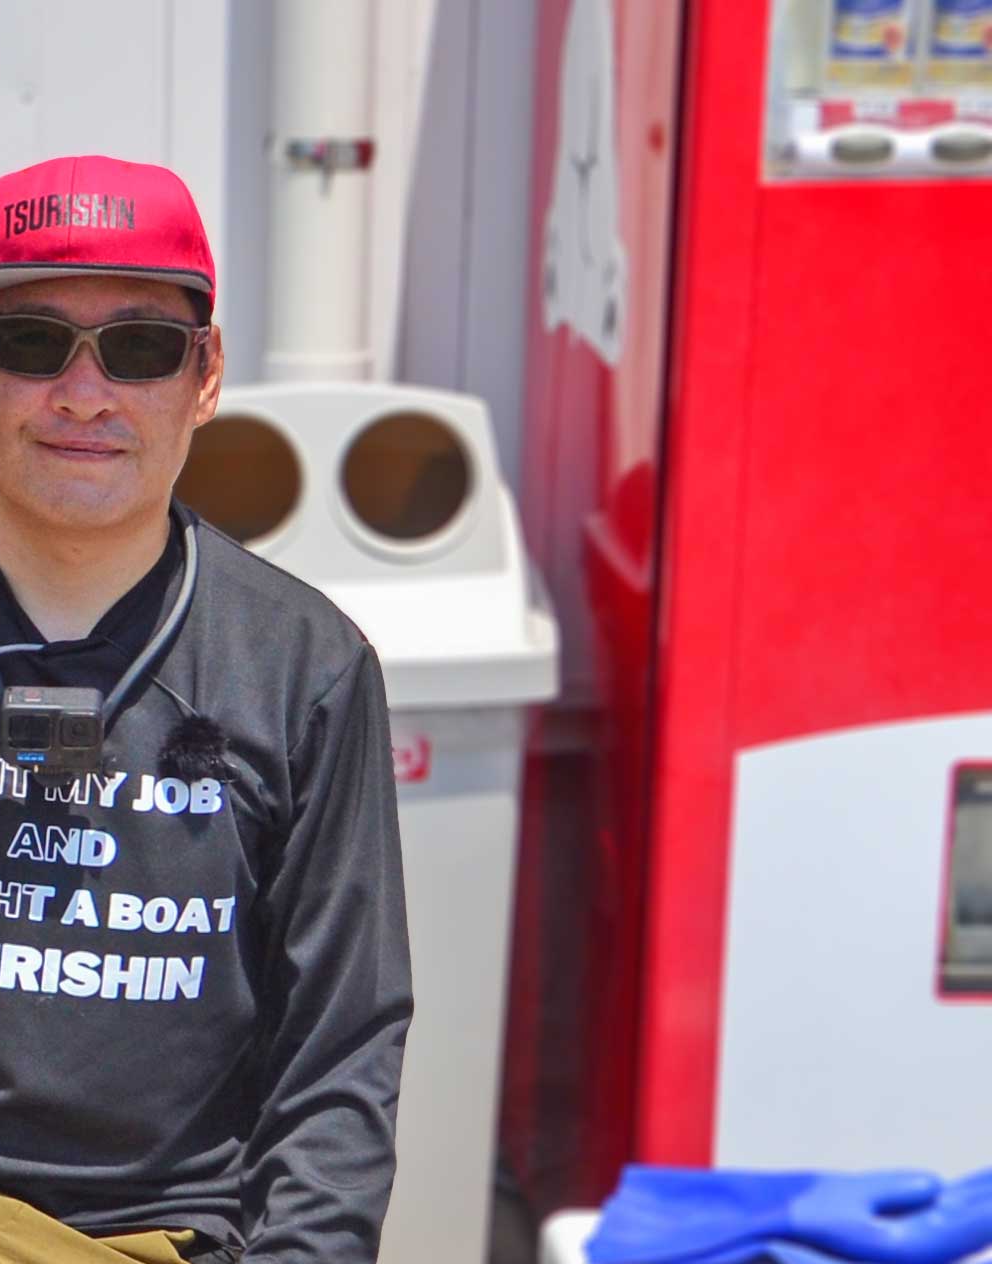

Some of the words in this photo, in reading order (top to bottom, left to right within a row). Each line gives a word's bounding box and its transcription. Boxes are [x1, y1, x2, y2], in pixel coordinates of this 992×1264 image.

[4, 192, 135, 239] TSURISHIN
[44, 770, 128, 808] MY
[132, 775, 223, 815] JOB
[7, 823, 117, 867] AND
[61, 889, 99, 928] A
[107, 892, 236, 934] BOAT
